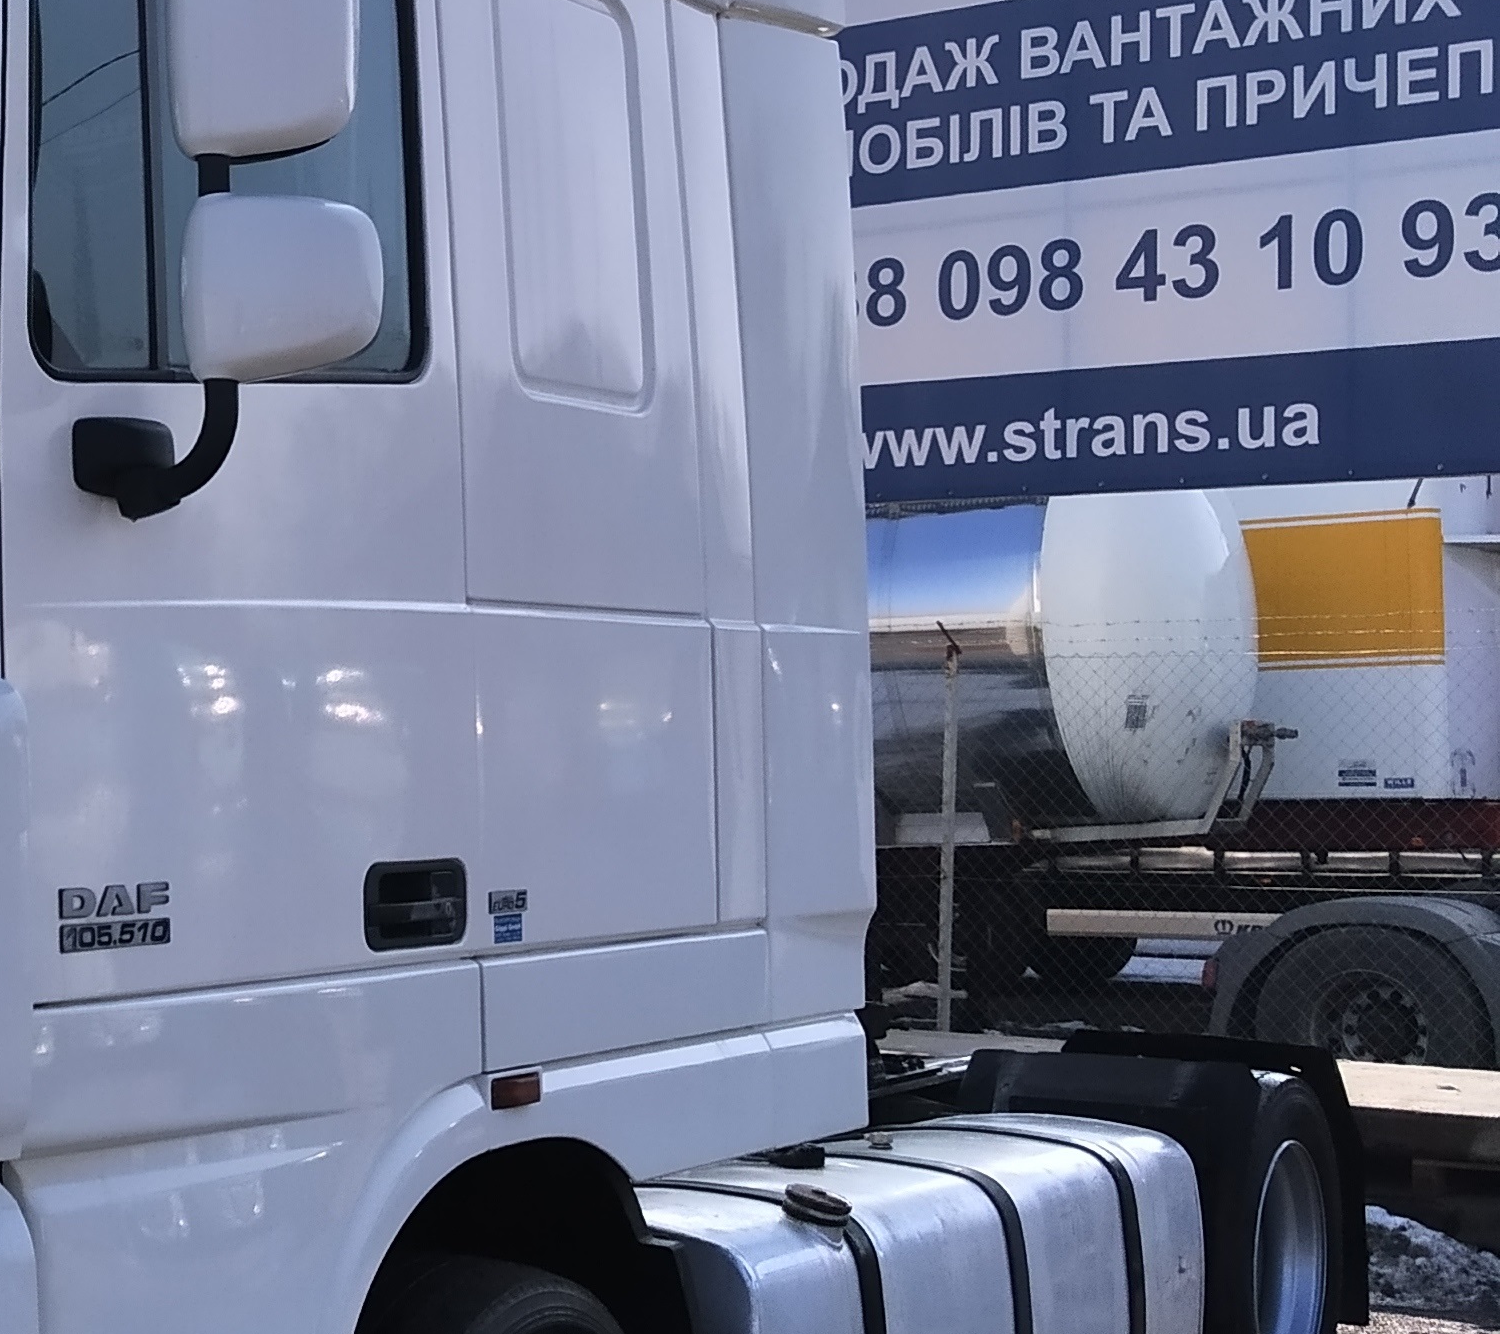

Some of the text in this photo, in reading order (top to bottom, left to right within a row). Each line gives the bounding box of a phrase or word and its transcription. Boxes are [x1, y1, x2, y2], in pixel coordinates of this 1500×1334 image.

[845, 38, 1494, 178] ОБІЛІВ ТА ПРИЧЕП
[854, 191, 1500, 328] 8 098 43 10 93
[58, 881, 170, 920] DAF
[63, 919, 169, 951] 105.510
